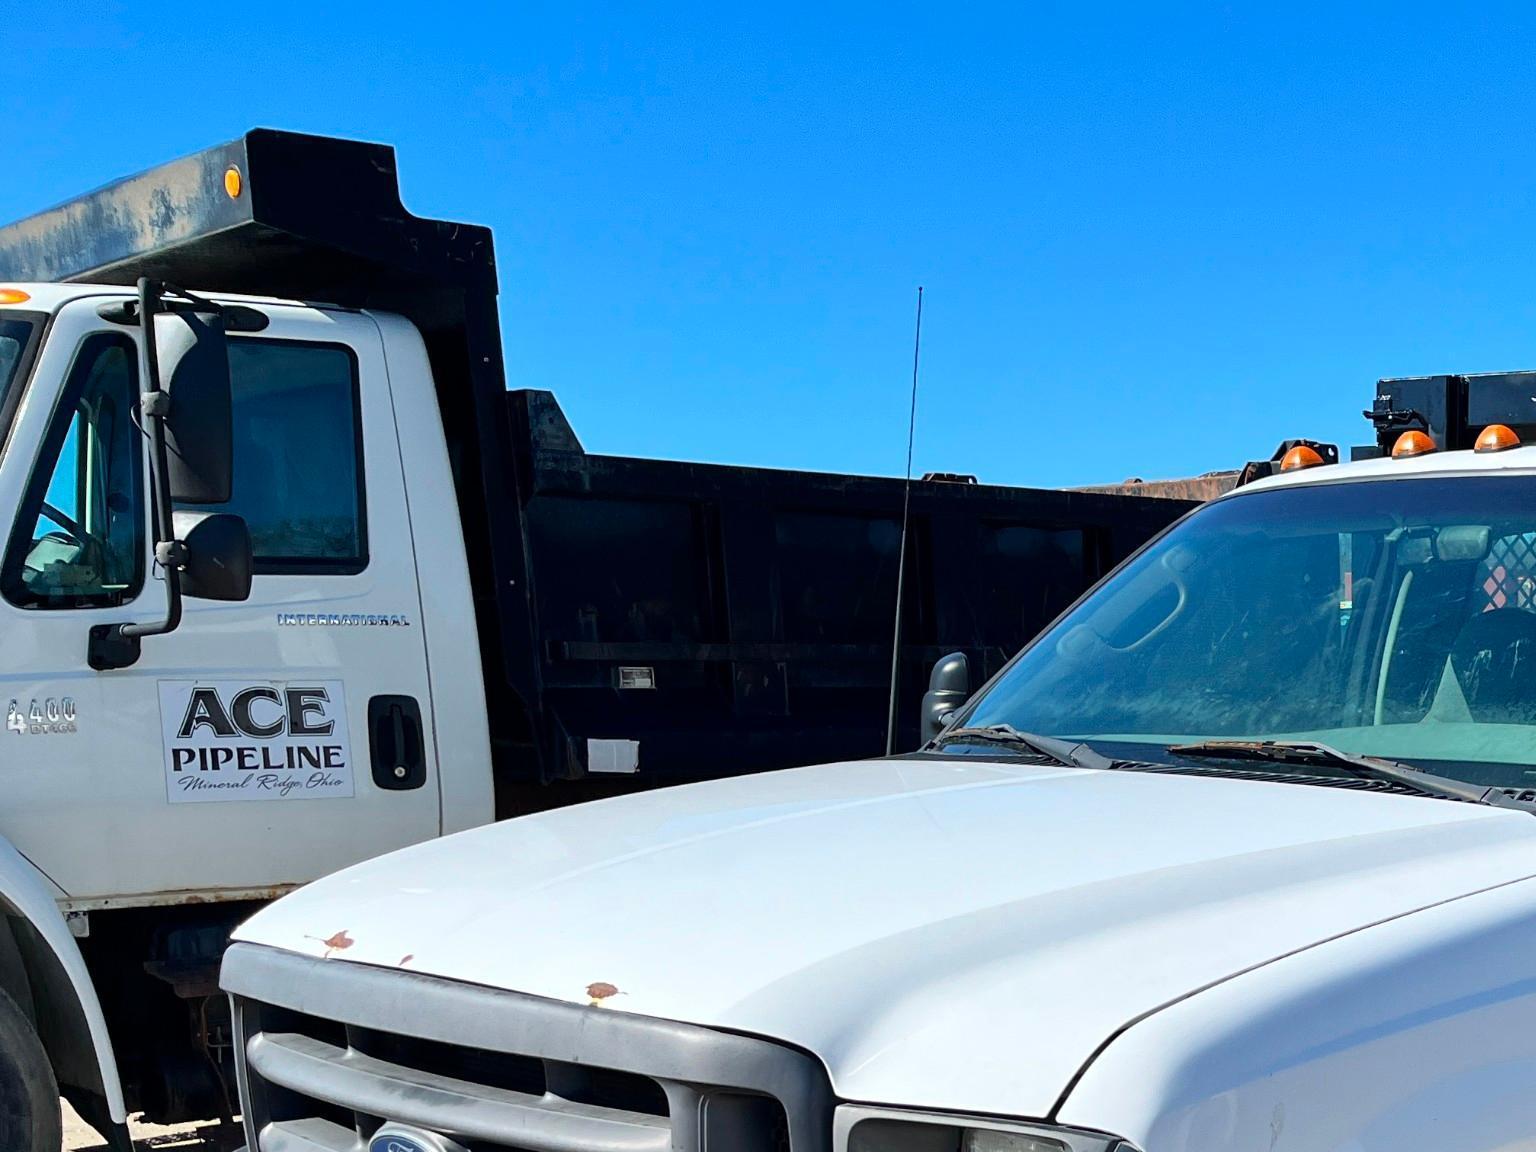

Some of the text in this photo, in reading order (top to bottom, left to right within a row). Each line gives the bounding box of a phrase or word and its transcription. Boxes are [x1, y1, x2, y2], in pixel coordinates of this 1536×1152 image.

[277, 613, 410, 626] INTERNATIONAL
[6, 697, 77, 735] 4400
[177, 686, 335, 739] ACE
[171, 745, 345, 772] PIPELINE
[178, 772, 254, 791] Mineral
[305, 771, 343, 789] Ohio
